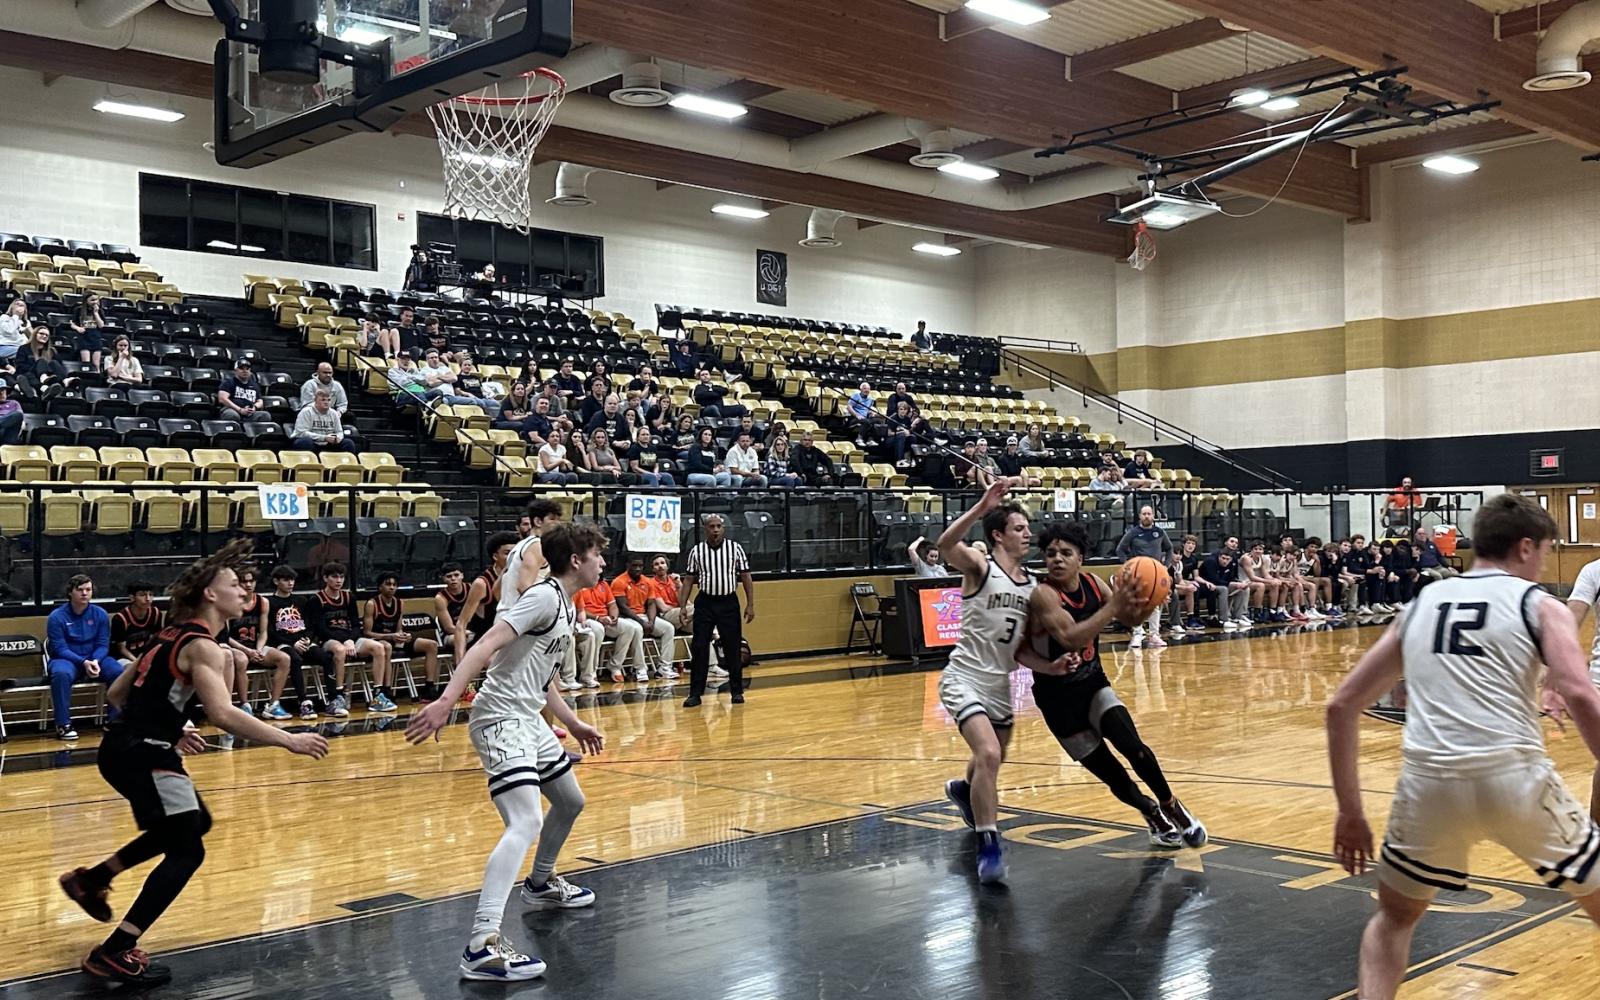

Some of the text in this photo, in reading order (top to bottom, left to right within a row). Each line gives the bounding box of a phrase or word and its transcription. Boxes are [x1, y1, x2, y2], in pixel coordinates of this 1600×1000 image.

[266, 492, 299, 515] KBB
[631, 498, 680, 520] BEAT
[401, 616, 431, 626] CLYDE
[997, 617, 1018, 645] 3
[1432, 602, 1488, 656] 12
